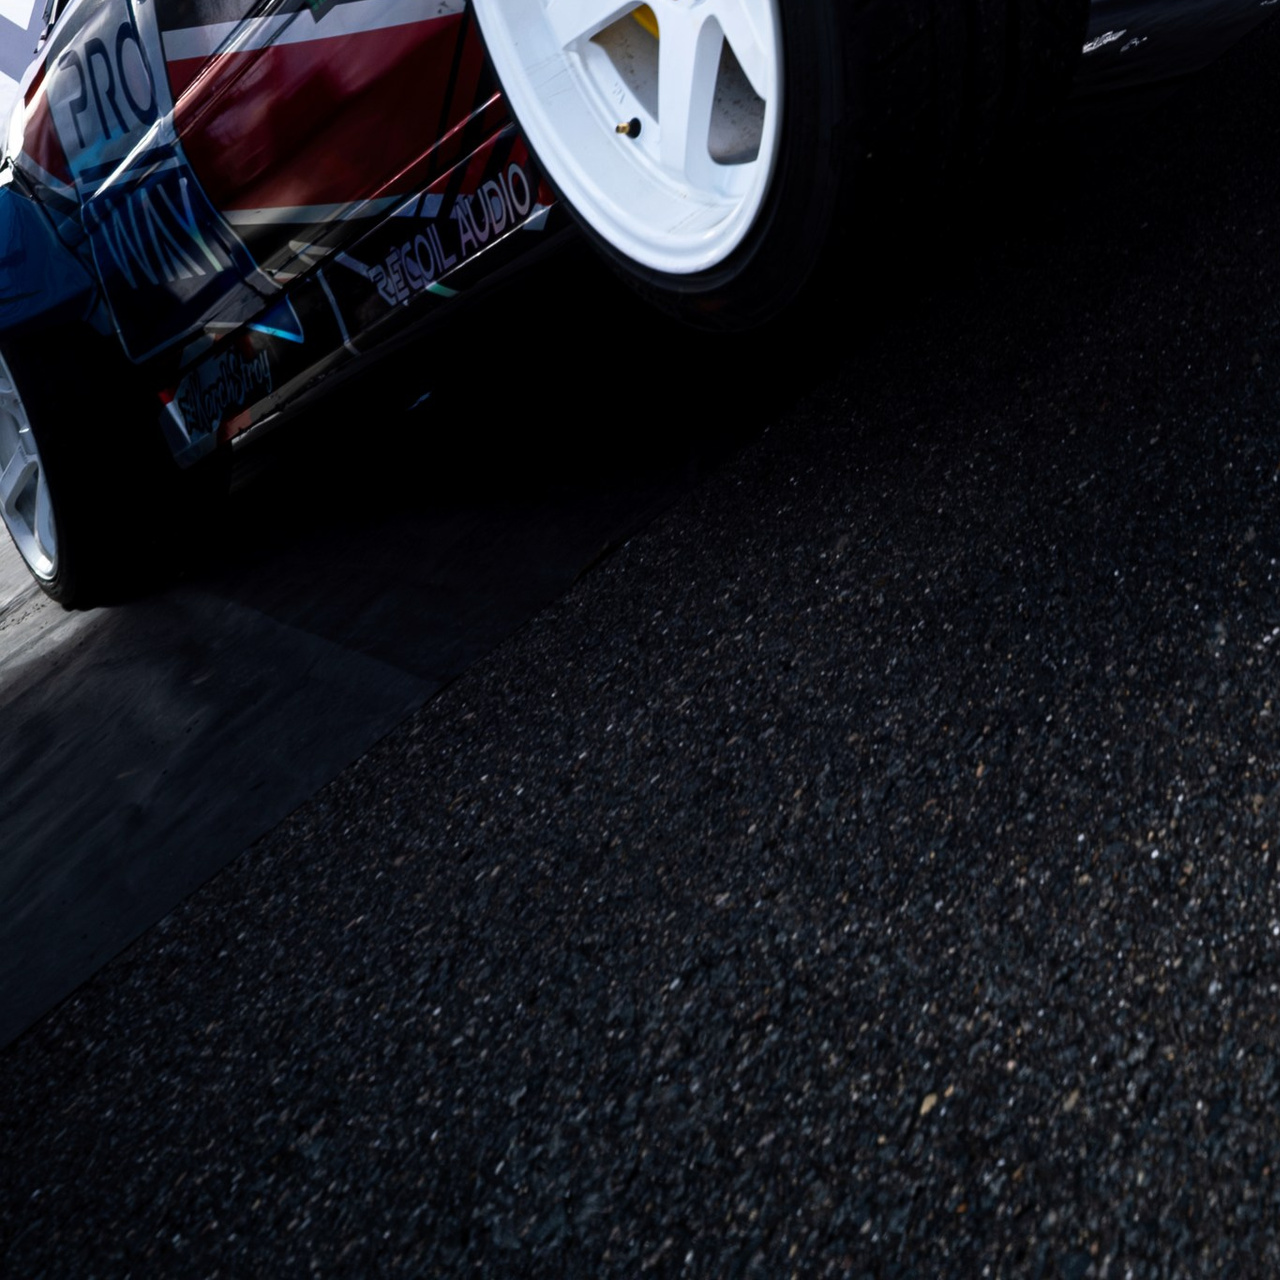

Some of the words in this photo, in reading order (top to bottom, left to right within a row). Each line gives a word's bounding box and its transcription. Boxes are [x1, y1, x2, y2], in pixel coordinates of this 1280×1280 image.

[58, 22, 158, 148] PRO
[367, 223, 458, 307] RECOIL
[455, 162, 532, 257] AUDIO
